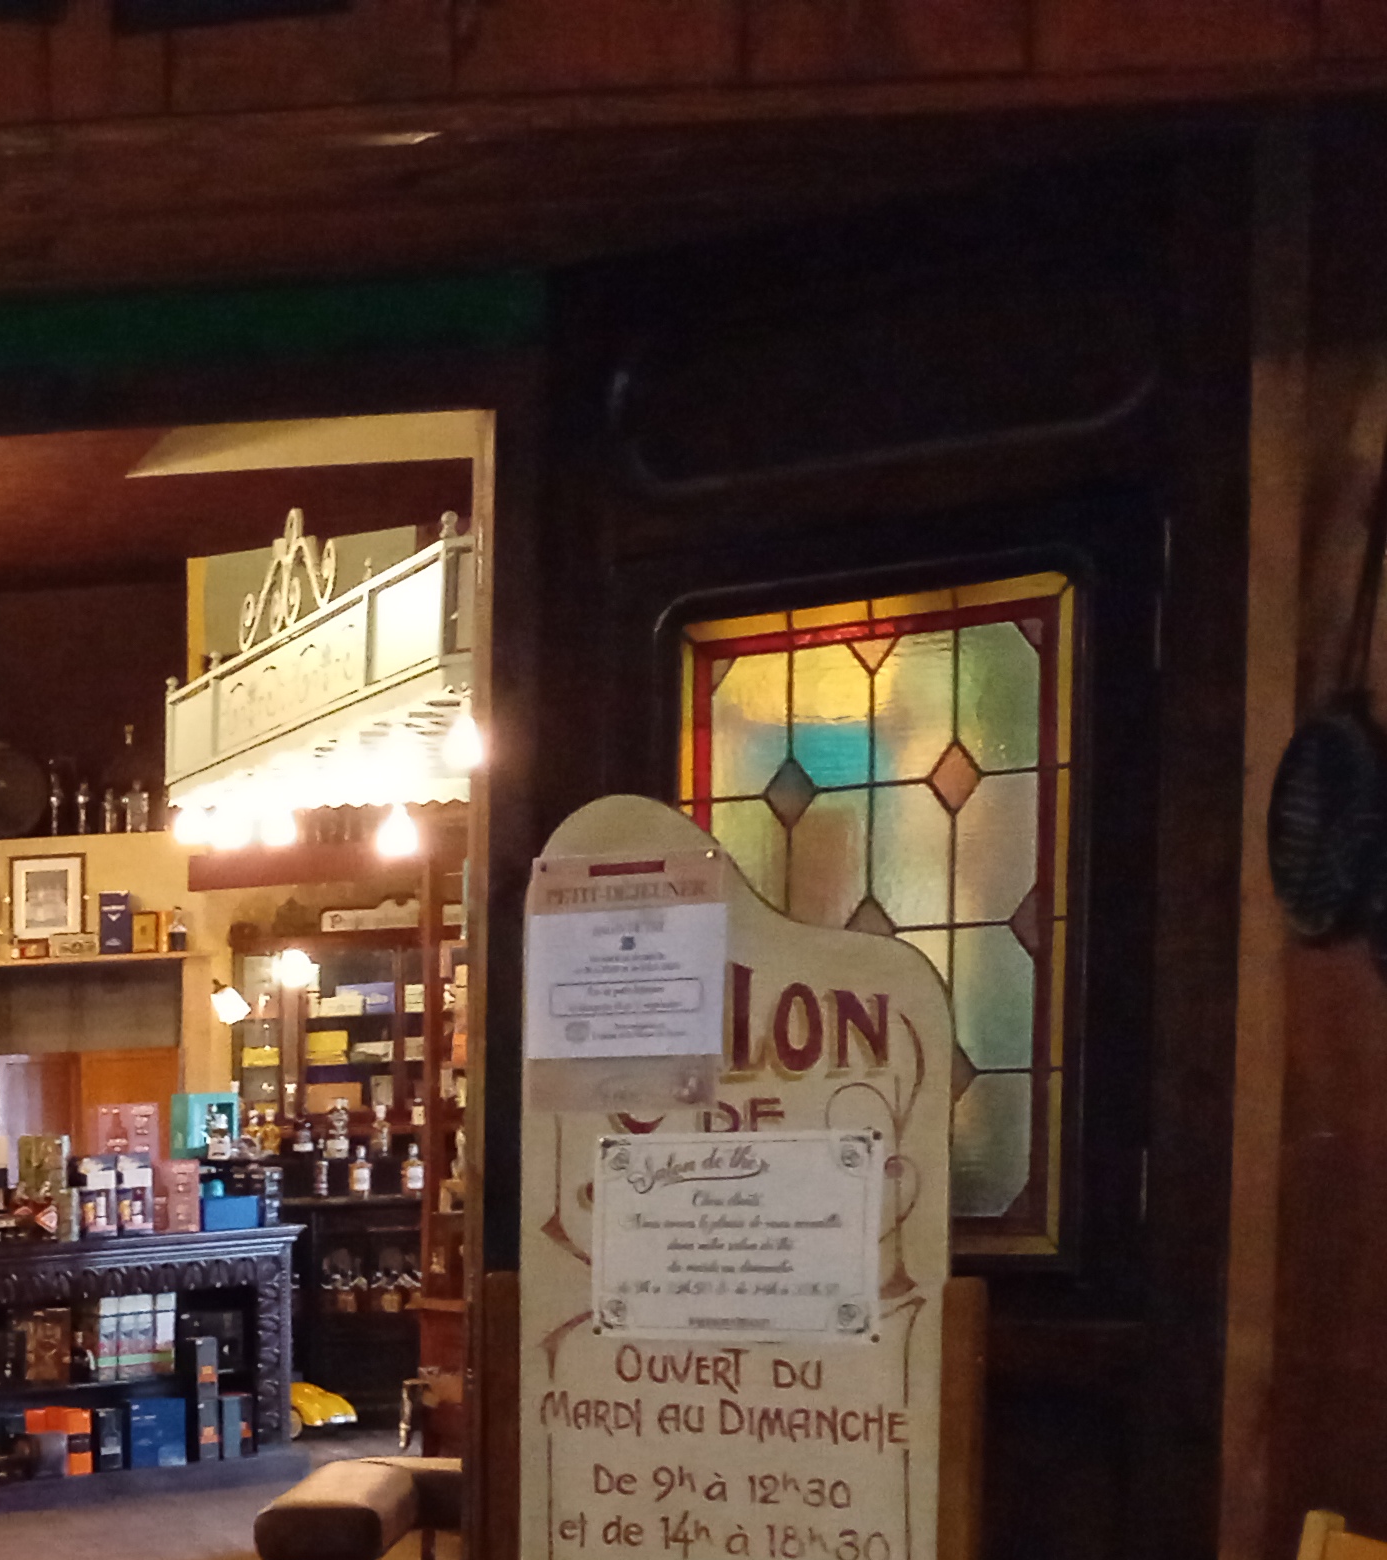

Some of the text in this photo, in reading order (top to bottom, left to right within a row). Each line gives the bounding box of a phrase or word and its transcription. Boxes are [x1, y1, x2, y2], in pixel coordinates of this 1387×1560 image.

[730, 963, 889, 1072] LON
[616, 1344, 823, 1394] OUVERT DU
[540, 1390, 909, 1452] MARDI AU DIMANCHE
[593, 1463, 851, 1509] De 9h à 12h30
[559, 1511, 586, 1548] et
[602, 1515, 644, 1547] de
[660, 1509, 712, 1560] 14h
[726, 1523, 750, 1557] à
